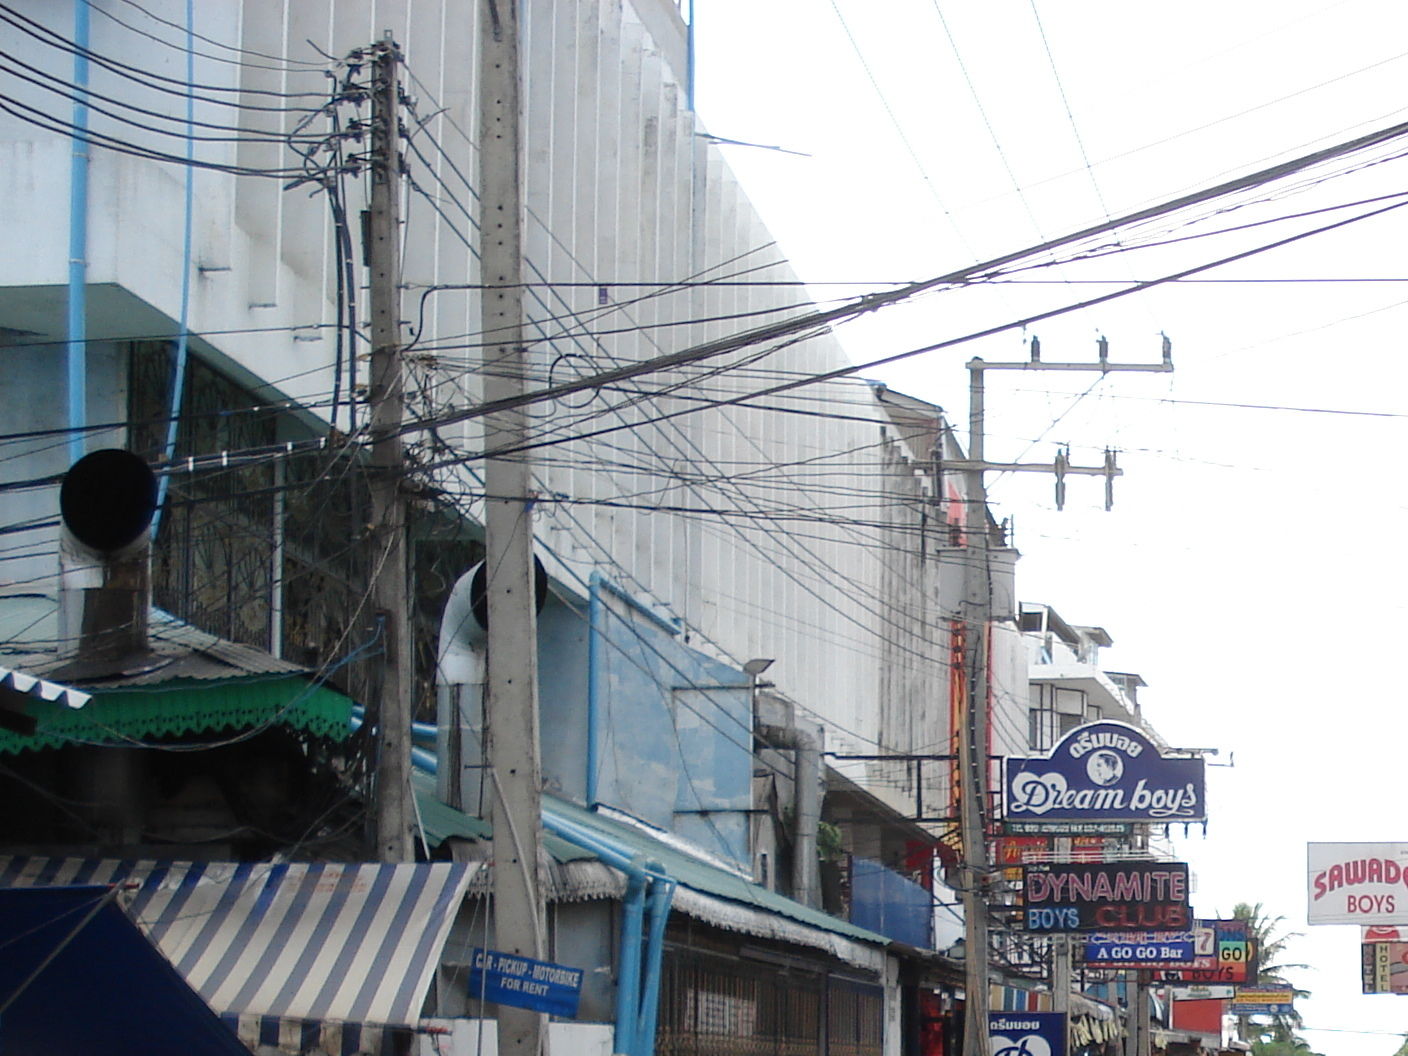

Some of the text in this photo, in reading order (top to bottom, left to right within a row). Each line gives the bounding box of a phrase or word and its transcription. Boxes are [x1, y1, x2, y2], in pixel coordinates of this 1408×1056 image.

[1011, 778, 1197, 817] Dream boys
[1027, 871, 1186, 903] DYNAMITE
[1028, 904, 1189, 930] BOYS CLUB
[1347, 894, 1396, 914] BOYS
[1097, 947, 1184, 960] A GO GO Bar
[1222, 947, 1243, 961] GO
[497, 957, 528, 977] PICKUP
[533, 964, 580, 988] MOTORBIKE
[1379, 945, 1388, 992] HOTEL
[500, 977, 549, 997] FOR RENT
